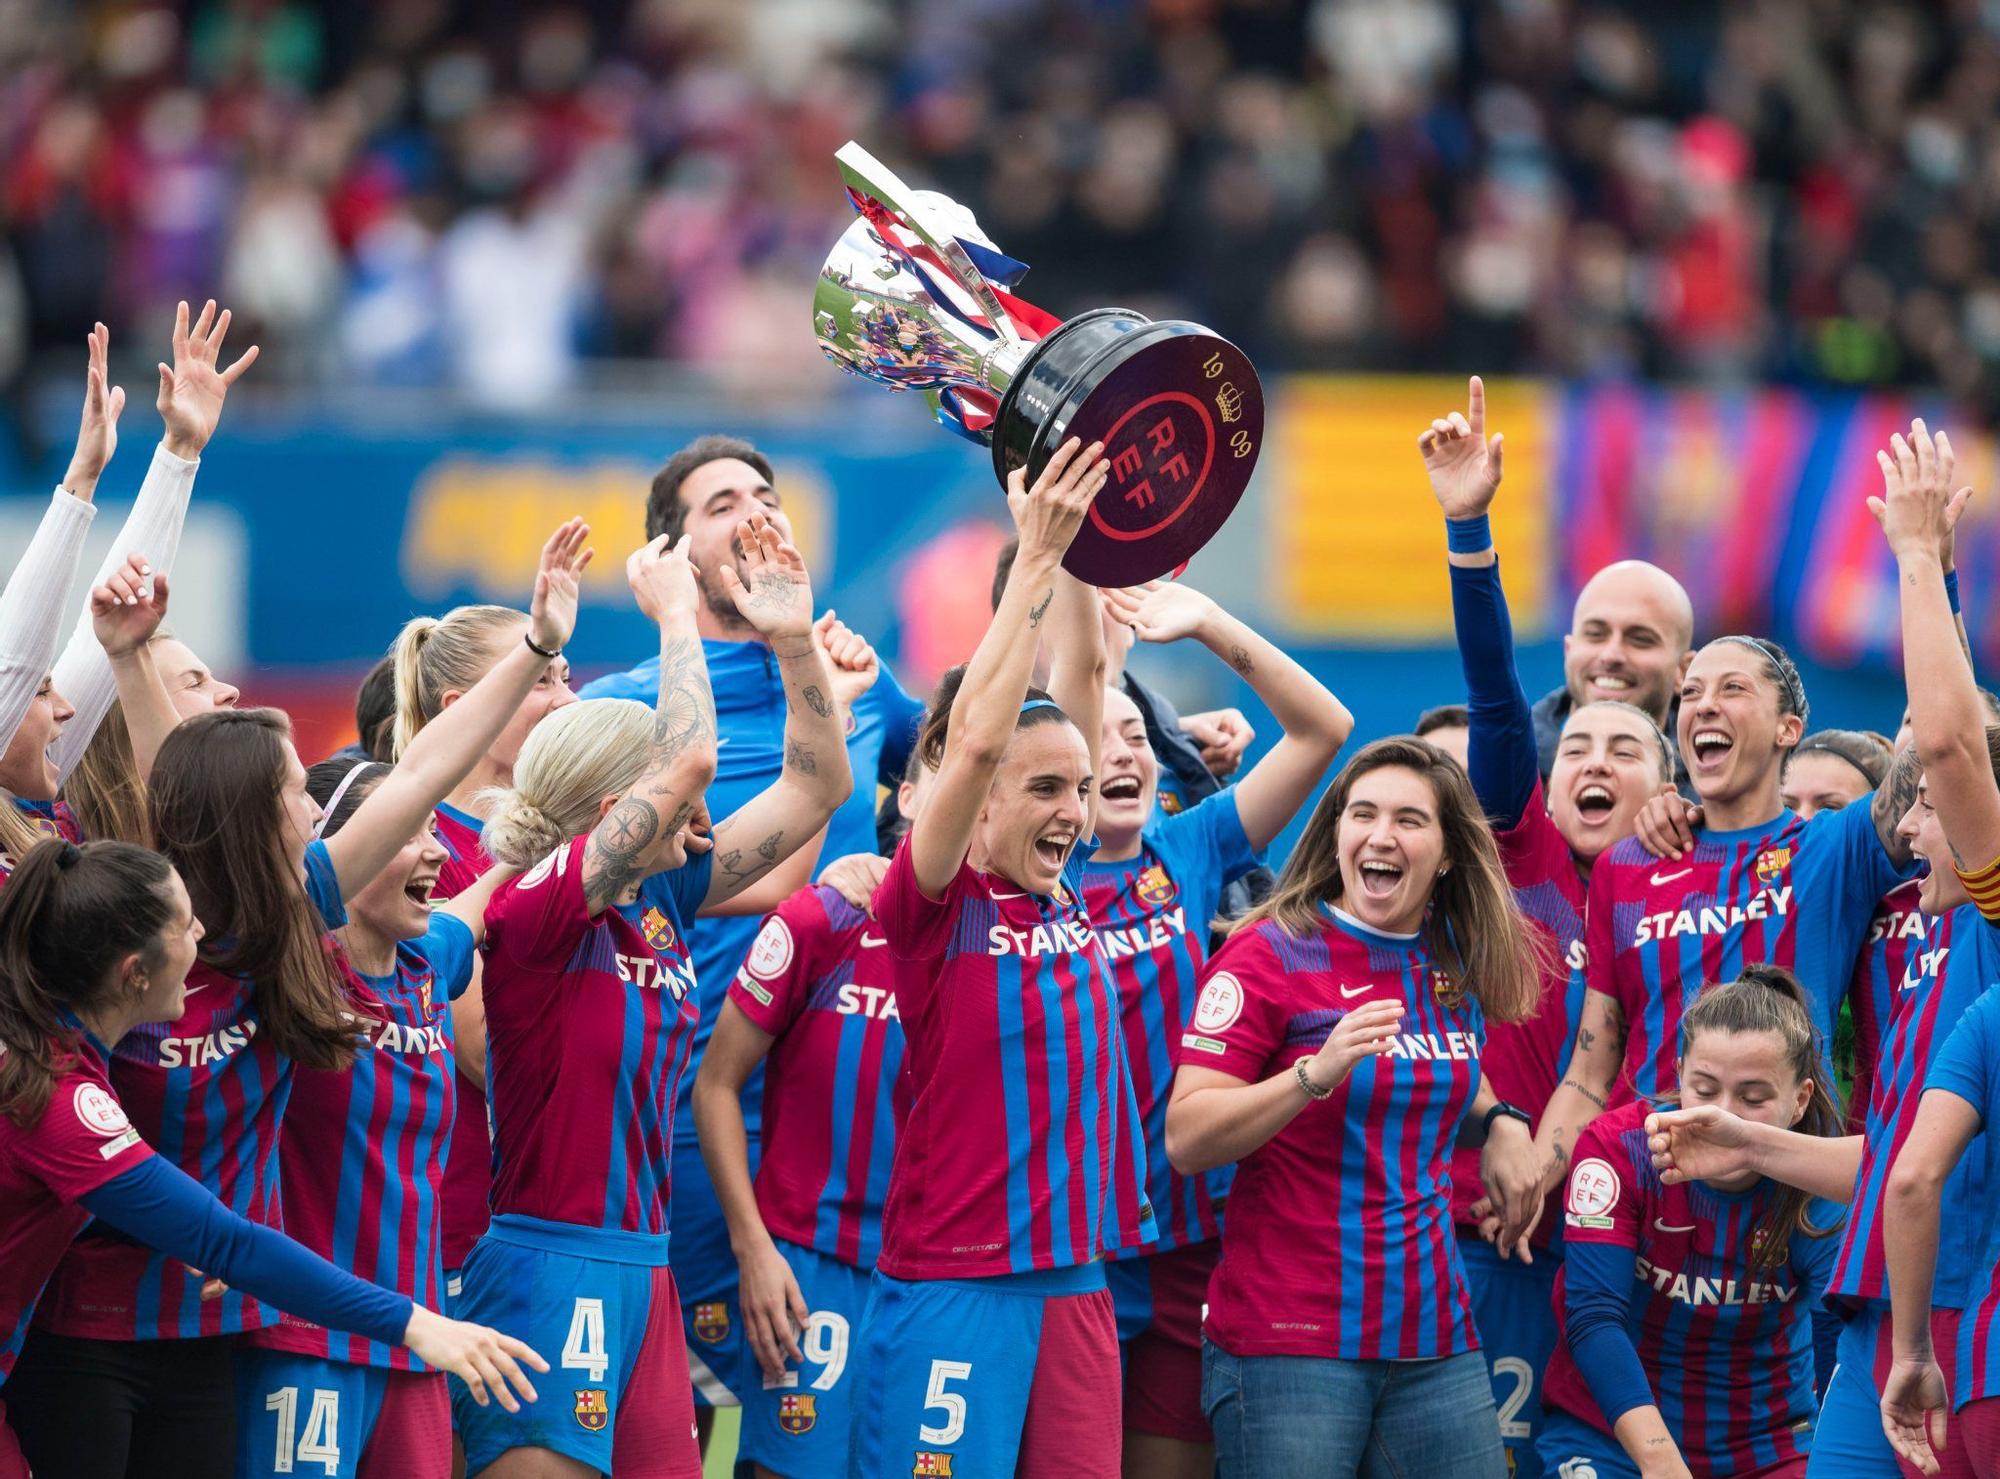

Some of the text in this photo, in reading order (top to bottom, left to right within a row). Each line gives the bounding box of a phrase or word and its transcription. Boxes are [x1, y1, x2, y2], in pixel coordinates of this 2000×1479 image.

[1202, 351, 1252, 458] 19 09
[1634, 886, 1792, 947] STANLEY
[561, 1297, 608, 1382] 4
[266, 1386, 340, 1476] 14
[919, 1359, 972, 1445] 5
